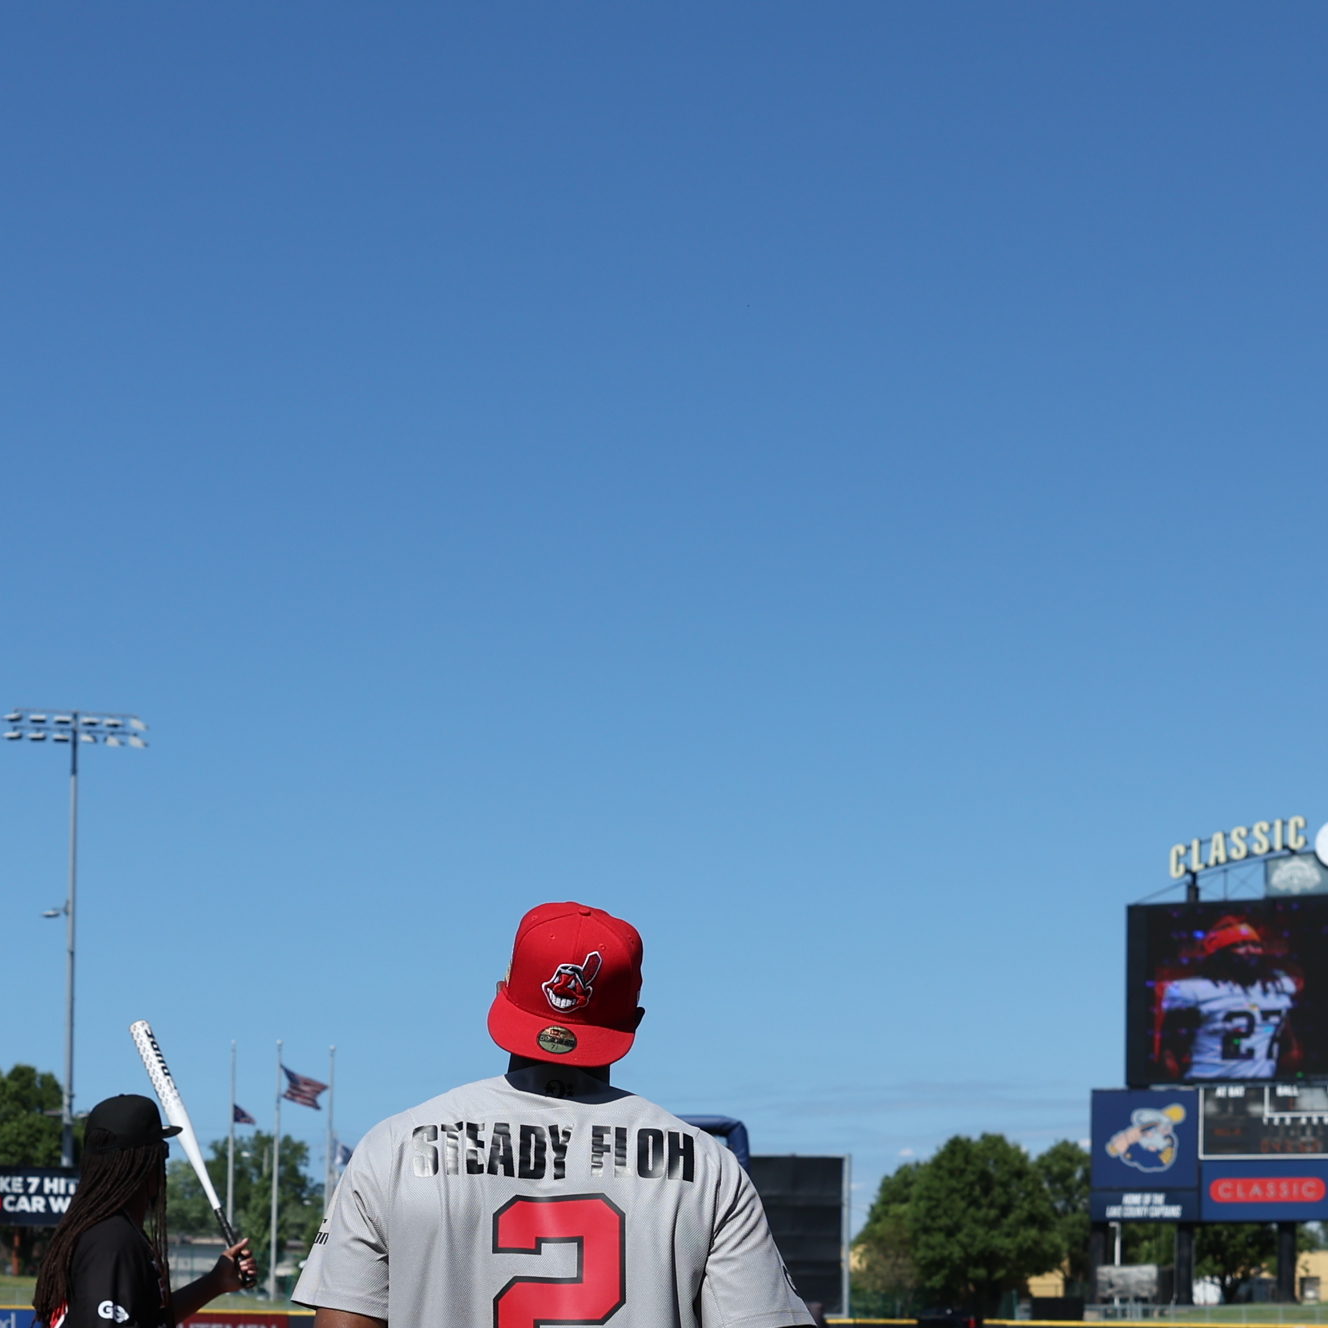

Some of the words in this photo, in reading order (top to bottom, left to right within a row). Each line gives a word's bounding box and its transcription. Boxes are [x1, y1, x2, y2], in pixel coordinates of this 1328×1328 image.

[1169, 815, 1308, 879] CLASSIC
[412, 1121, 572, 1180] STEADY
[26, 1177, 42, 1195] 7
[1218, 1181, 1317, 1198] CLASSIC
[2, 1196, 46, 1213] CAR
